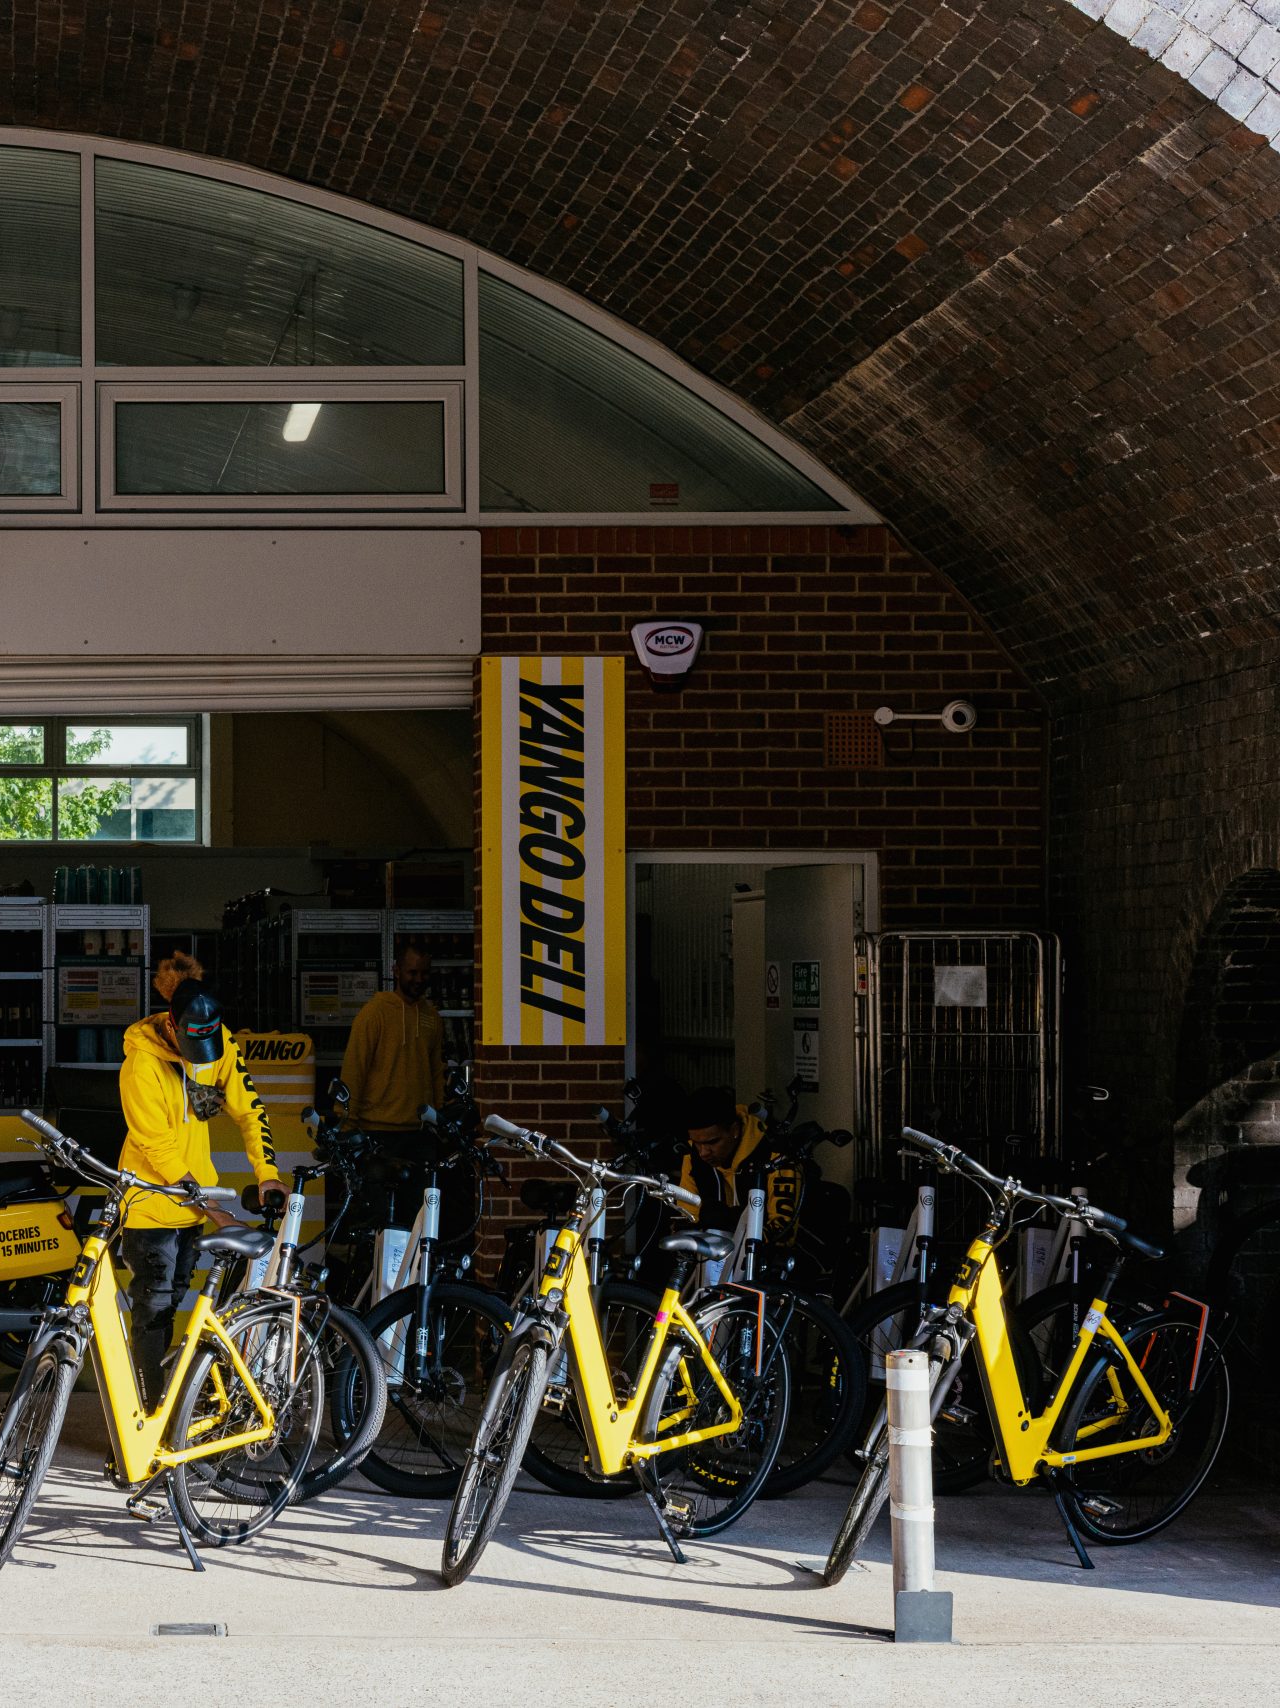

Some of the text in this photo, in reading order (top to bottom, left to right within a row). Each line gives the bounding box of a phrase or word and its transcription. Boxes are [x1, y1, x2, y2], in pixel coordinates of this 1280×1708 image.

[655, 635, 685, 645] MCW
[519, 678, 586, 1024] YANGO DELI
[244, 1039, 306, 1061] YANGO
[1, 1245, 12, 1257] 15
[14, 1238, 59, 1255] MINUTES
